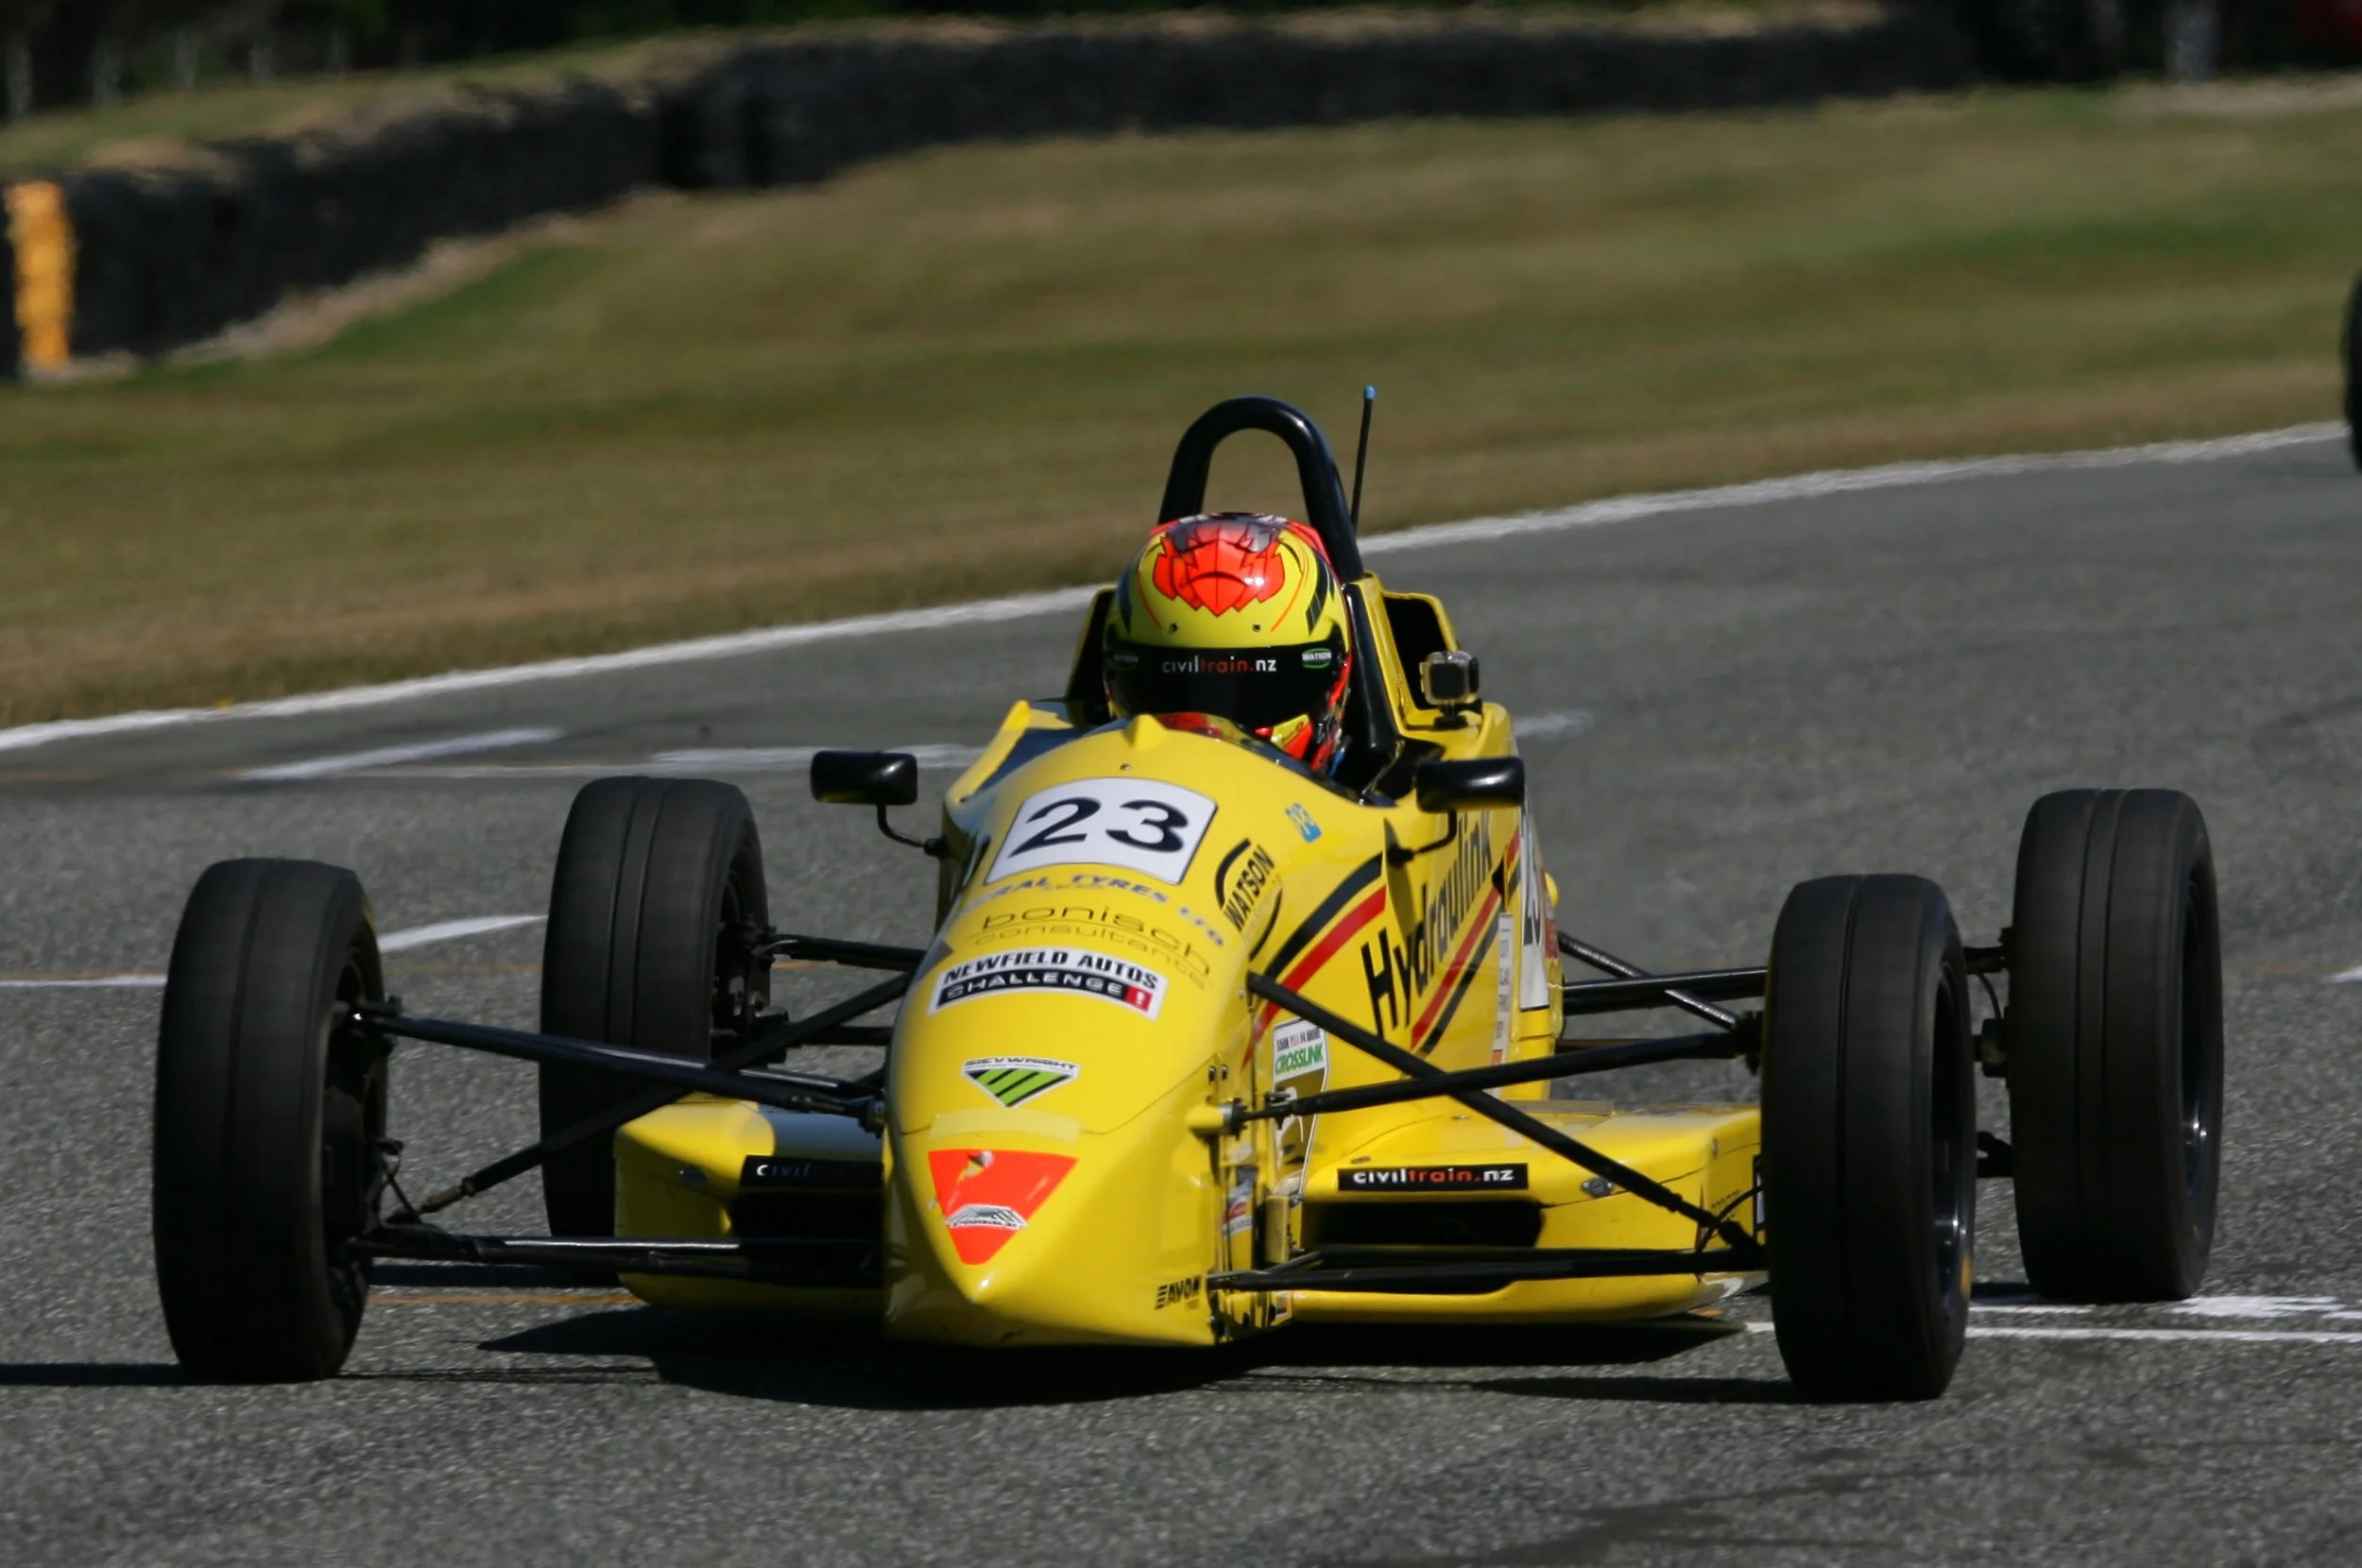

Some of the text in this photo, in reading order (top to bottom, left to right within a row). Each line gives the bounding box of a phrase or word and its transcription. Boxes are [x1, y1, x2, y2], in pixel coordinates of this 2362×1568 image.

[1162, 656, 1276, 673] civiltrain.nz
[1007, 797, 1189, 858] 23
[1223, 844, 1275, 932] WATSON
[982, 906, 1210, 976] bonisch
[945, 951, 1158, 990] NEWFIELD AUTOS
[947, 972, 1124, 998] CHALLENGE
[1276, 1043, 1323, 1075] CROSSLINK
[1353, 1167, 1514, 1185] civiltrain.nz
